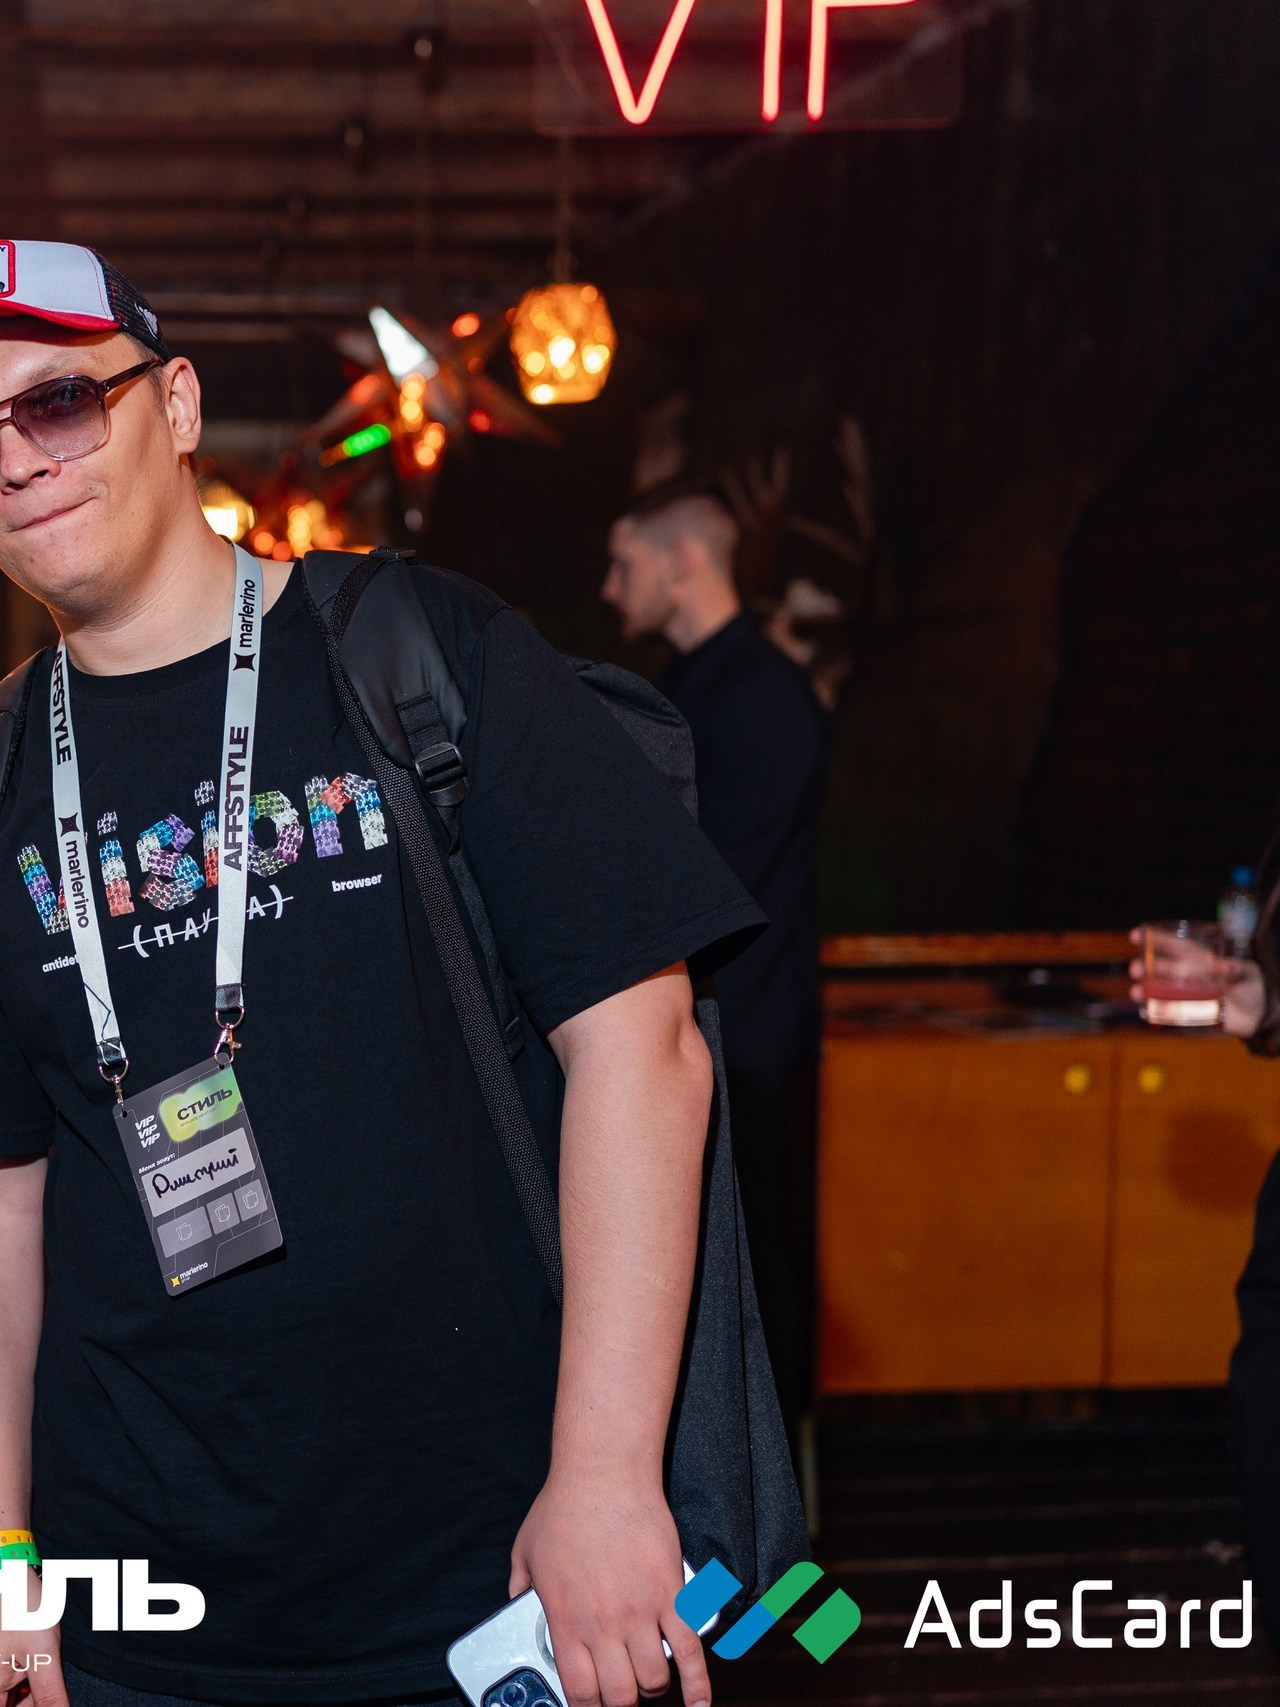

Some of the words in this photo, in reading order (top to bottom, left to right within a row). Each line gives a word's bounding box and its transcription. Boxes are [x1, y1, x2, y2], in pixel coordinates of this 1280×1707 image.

[238, 578, 256, 648] marlerino
[53, 650, 72, 766] AFFSTYLE
[224, 726, 249, 872] AFFSTYLE
[65, 840, 90, 929] marlerino
[331, 873, 383, 892] browser
[132, 884, 283, 958] (ПАУА)
[177, 1088, 233, 1121] СТИЛЬ
[135, 1114, 155, 1131] VIP
[138, 1123, 158, 1140] VIP
[141, 1132, 161, 1149] VIP
[179, 1261, 209, 1280] marlerino
